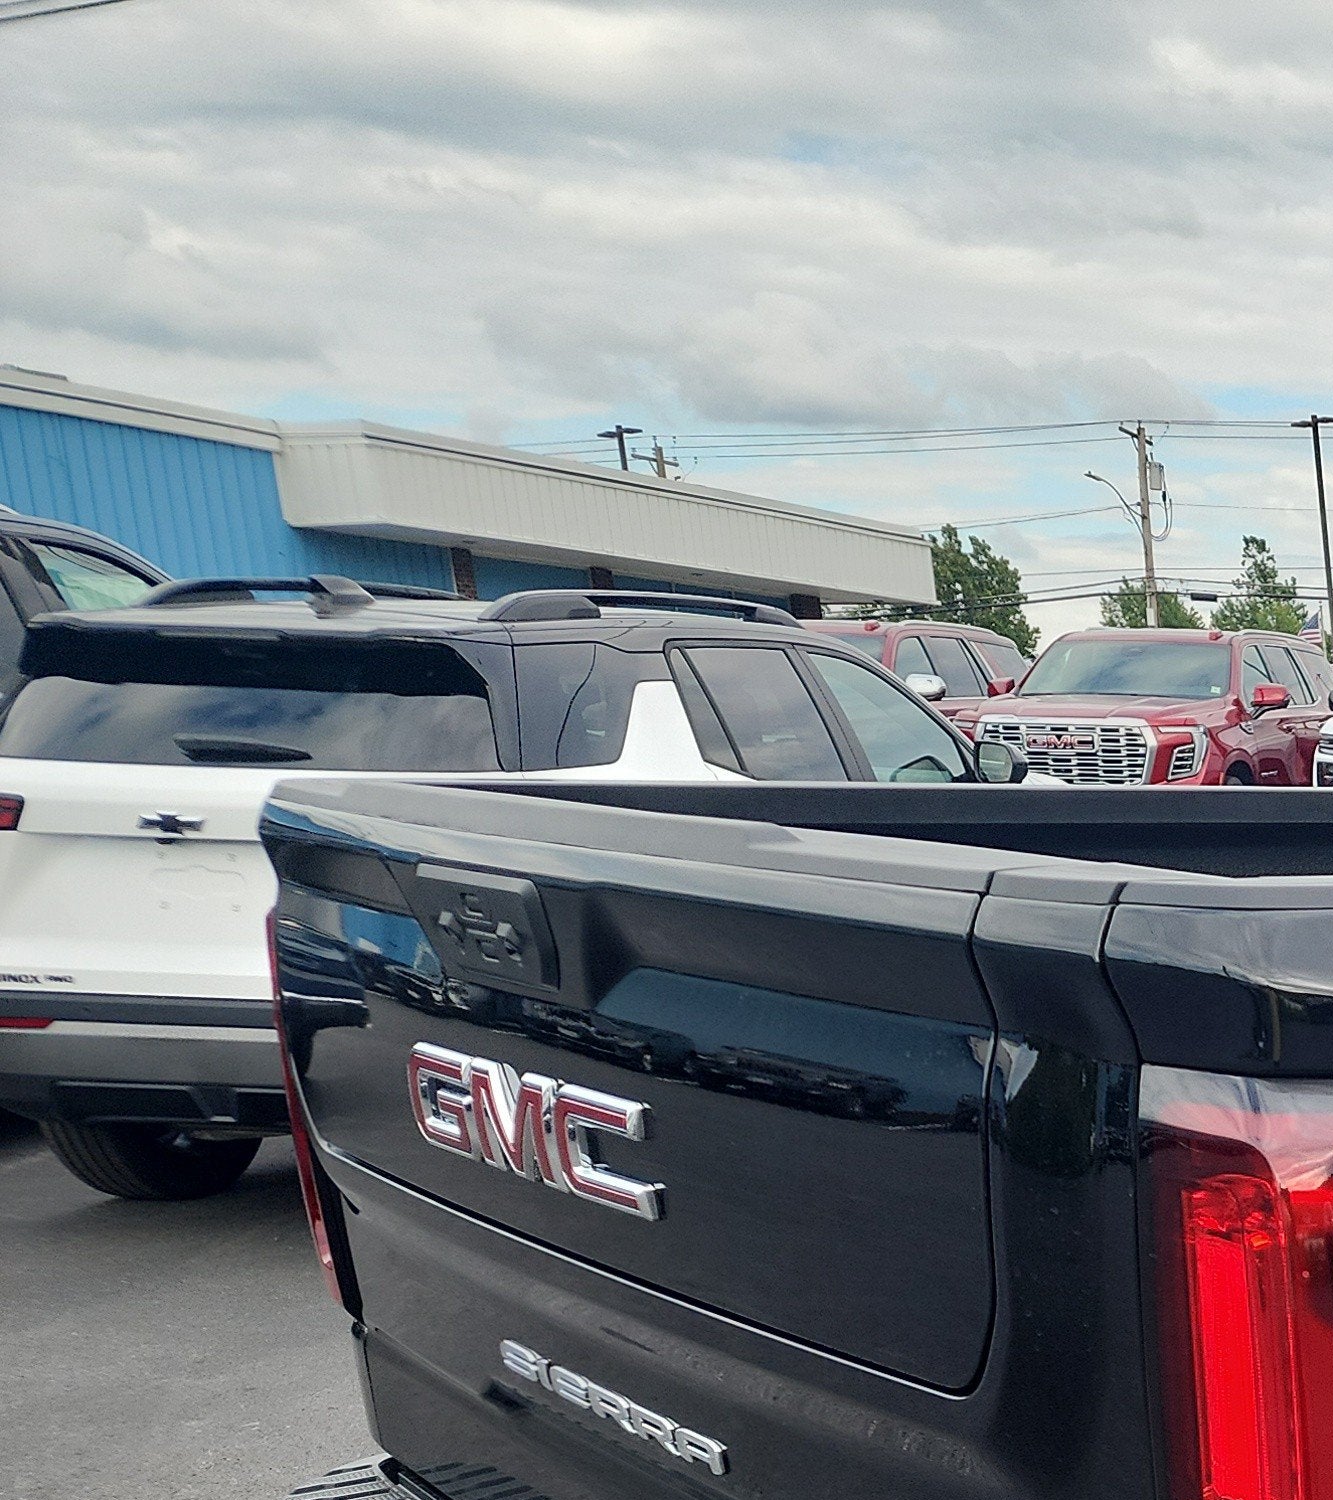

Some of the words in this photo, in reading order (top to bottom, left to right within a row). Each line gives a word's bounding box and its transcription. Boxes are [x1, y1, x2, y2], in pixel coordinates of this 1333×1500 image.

[1026, 734, 1094, 749] GMC
[407, 1041, 668, 1222] GMC
[500, 1339, 728, 1476] SIERRA
